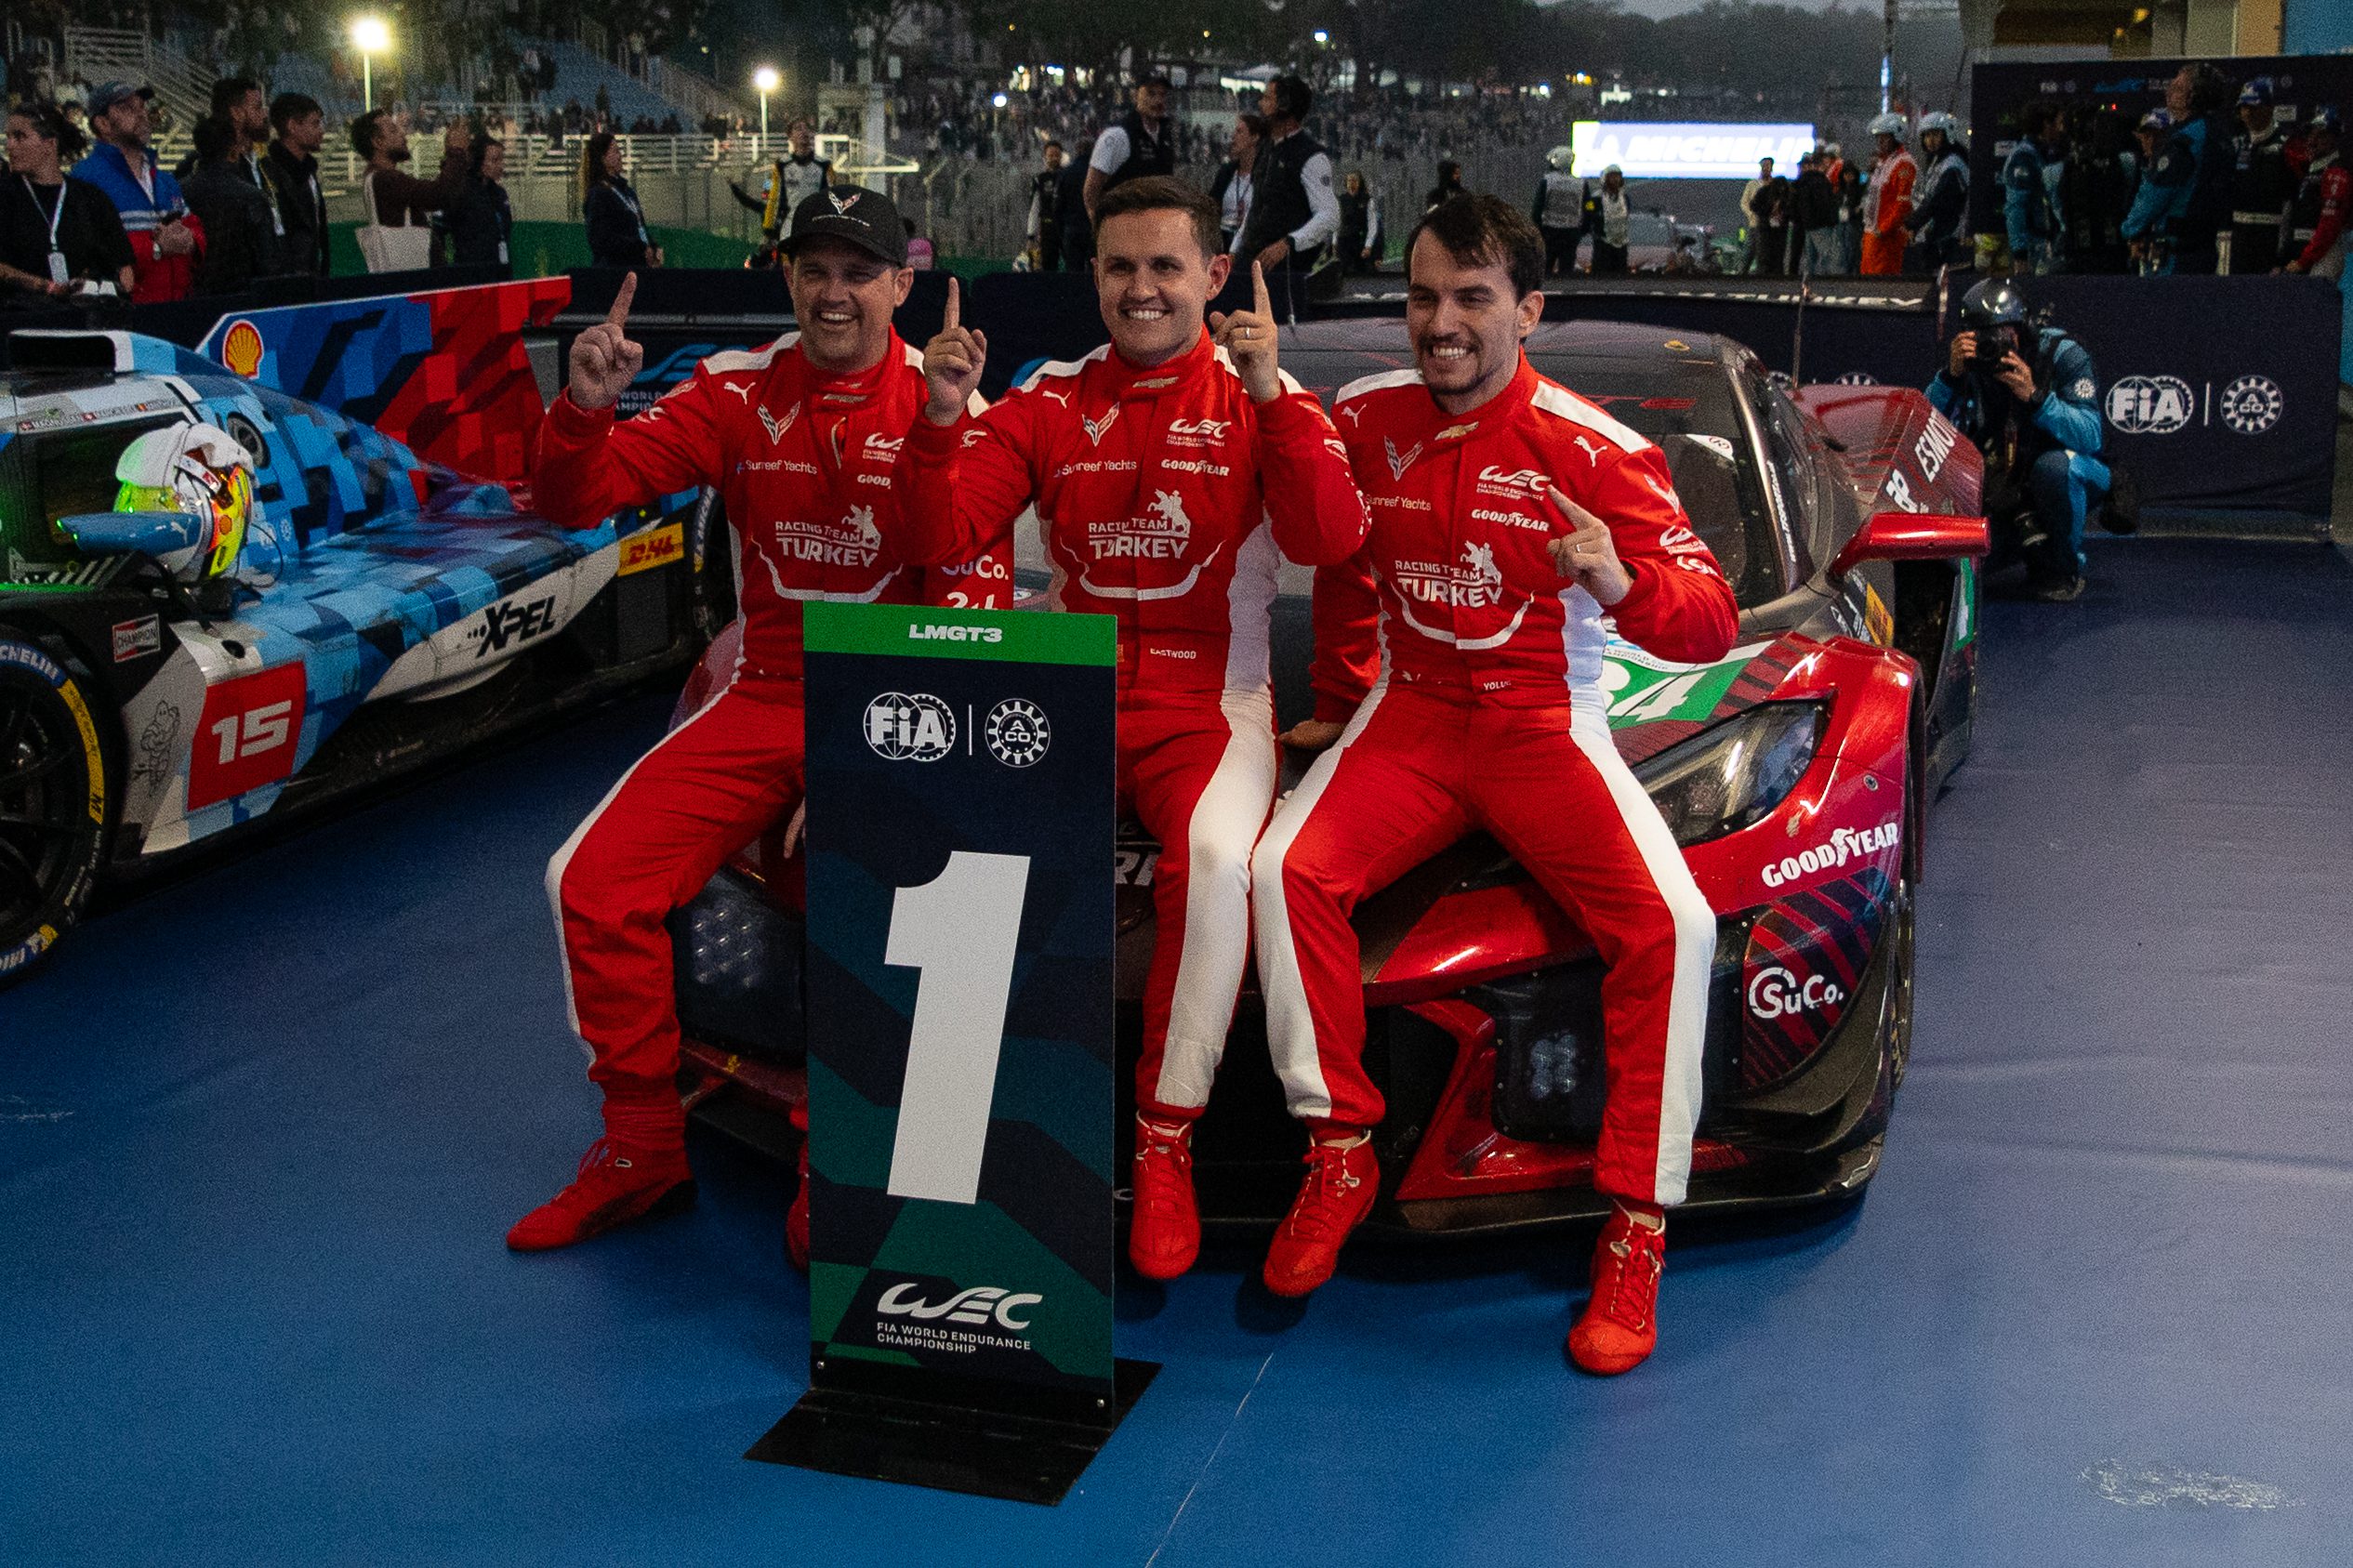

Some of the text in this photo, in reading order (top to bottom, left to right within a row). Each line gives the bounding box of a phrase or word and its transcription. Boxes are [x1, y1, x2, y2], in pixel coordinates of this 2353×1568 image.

[2112, 388, 2184, 421] FIA
[1169, 418, 1232, 440] WEC
[784, 459, 818, 475] Yachts
[1104, 459, 1137, 471] Yachts
[1160, 458, 1230, 477] GOODYEAR
[856, 473, 892, 490] GOOD
[1478, 465, 1553, 493] WEC
[1400, 496, 1432, 511] Yachts
[774, 520, 823, 534] RACING
[1088, 517, 1169, 534] RACIN TEAM
[1471, 508, 1551, 533] GOODYEAR
[775, 536, 879, 569] TURKEY
[1395, 560, 1481, 581] RACING TEAM
[1396, 577, 1503, 608] TURKEY
[476, 595, 557, 658] XPEL
[908, 624, 1004, 644] LMGT3
[1149, 647, 1197, 660] EASTWOOD
[210, 699, 293, 766] 15
[870, 705, 947, 749] FIA
[1761, 822, 1899, 889] GOODYEAR
[884, 850, 1032, 1206] 1
[877, 1282, 1044, 1331] WEC
[876, 1321, 1032, 1351] FIA WORLD ENDURANCE
[876, 1332, 977, 1354] CHAMPIONSHIP
